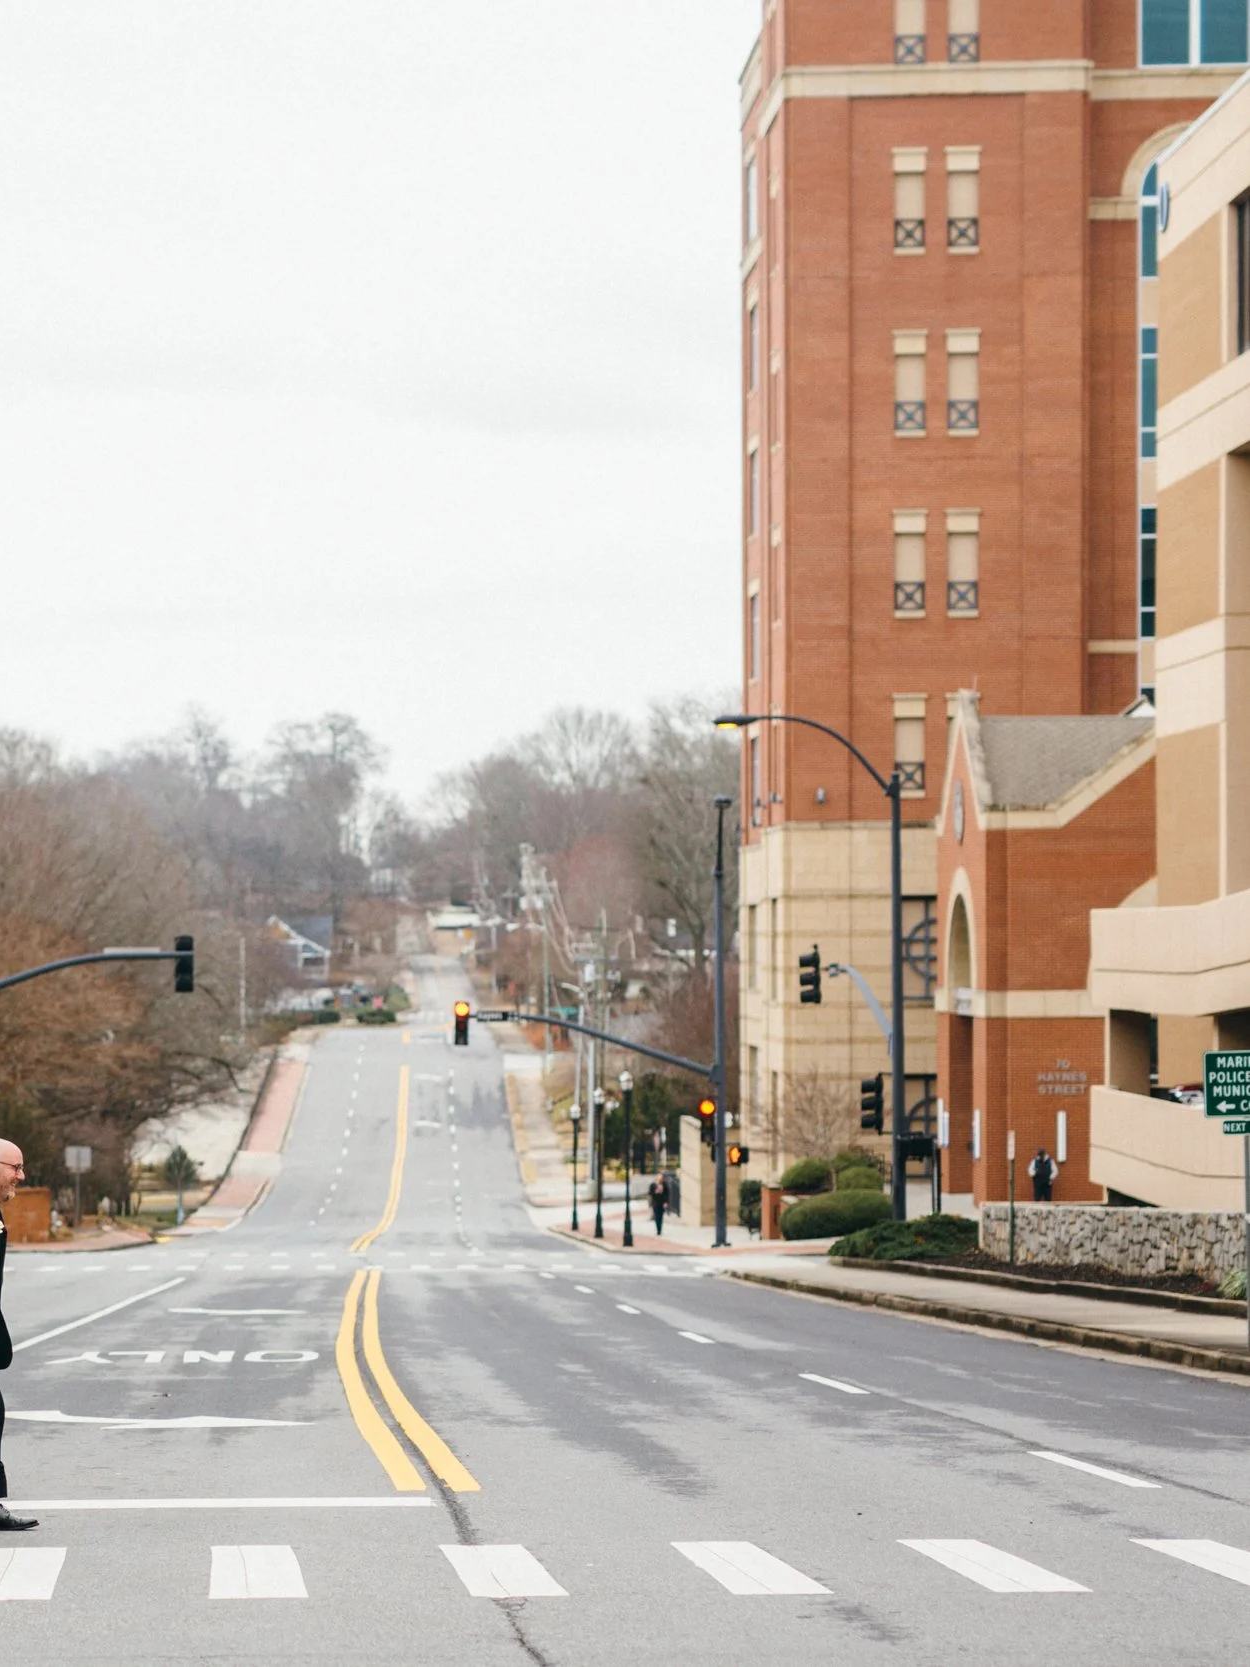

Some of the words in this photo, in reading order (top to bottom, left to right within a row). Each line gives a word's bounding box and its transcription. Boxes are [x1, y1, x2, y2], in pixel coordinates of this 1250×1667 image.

[1216, 1056, 1250, 1068] MARI
[1037, 1072, 1087, 1082] HAYNES
[1209, 1071, 1250, 1084] POLICE
[1038, 1084, 1085, 1096] STREET
[1240, 1100, 1250, 1112] C
[1223, 1123, 1246, 1133] NEXT
[45, 1350, 320, 1365] ONLY
